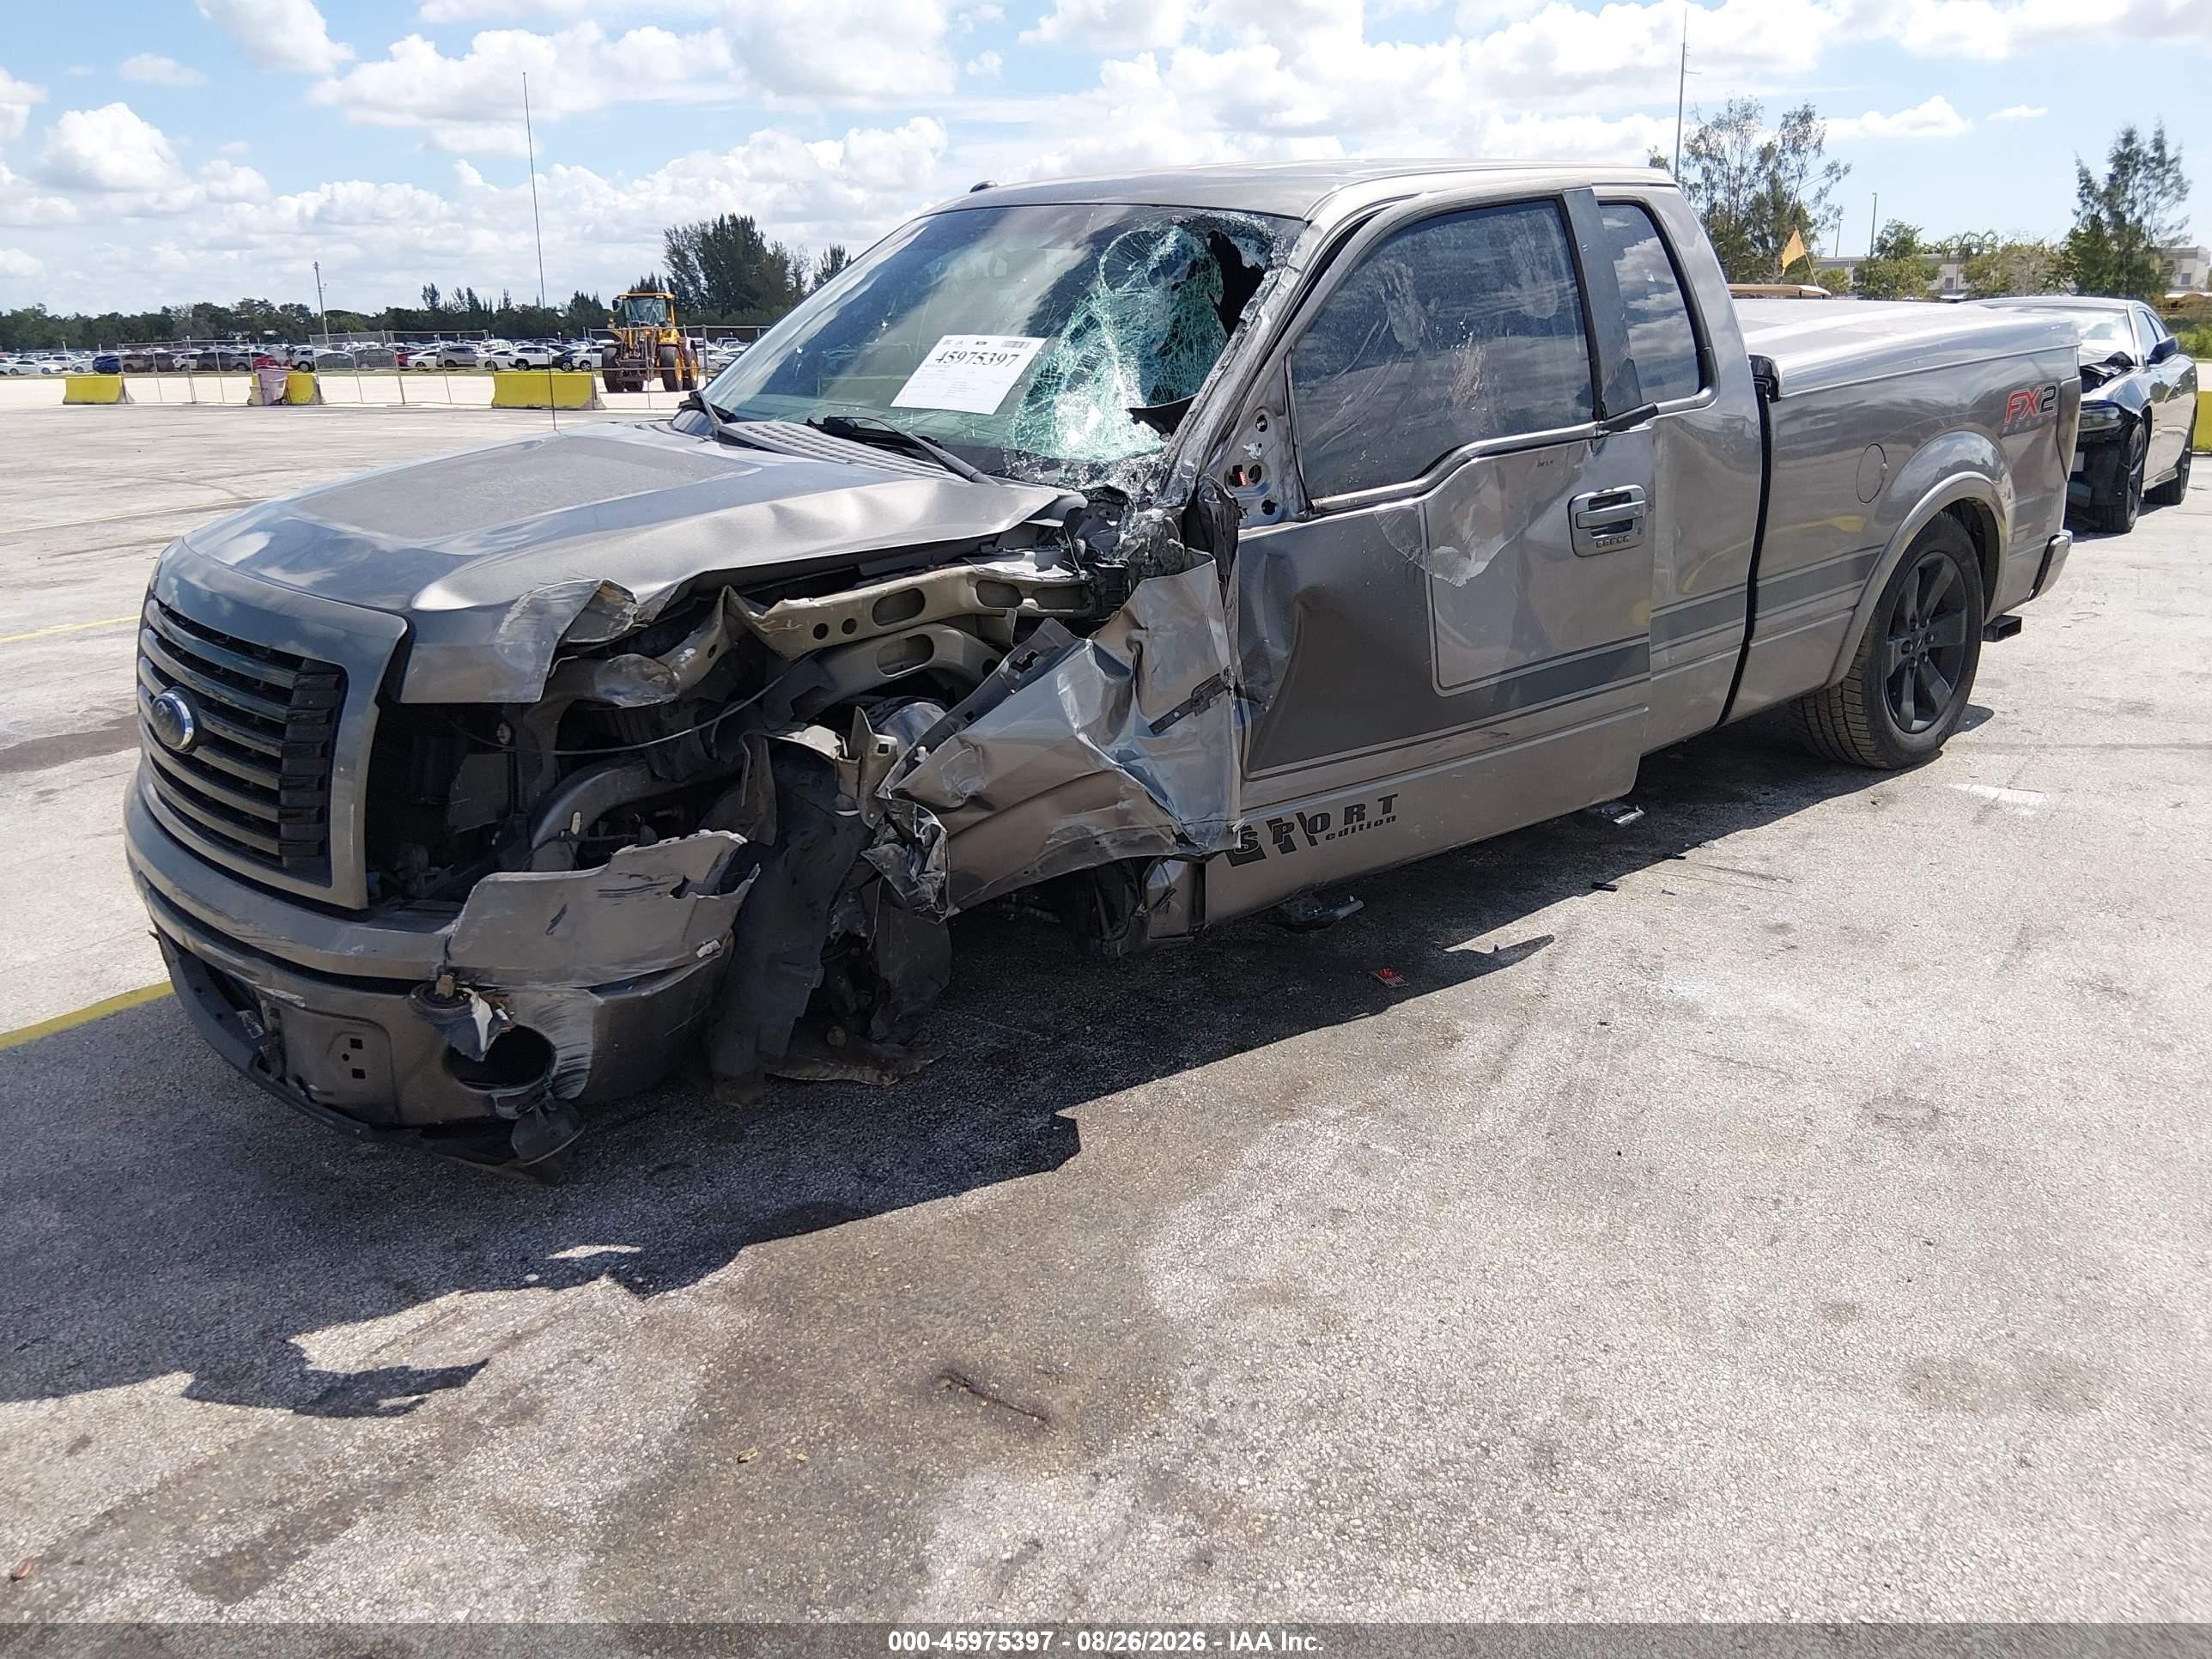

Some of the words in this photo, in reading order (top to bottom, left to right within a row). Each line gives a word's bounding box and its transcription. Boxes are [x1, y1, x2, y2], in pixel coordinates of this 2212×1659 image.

[935, 350, 1020, 367] 45975397
[2005, 384, 2057, 422] FX2
[1233, 793, 1400, 856] SPORT
[1325, 815, 1397, 841] edition
